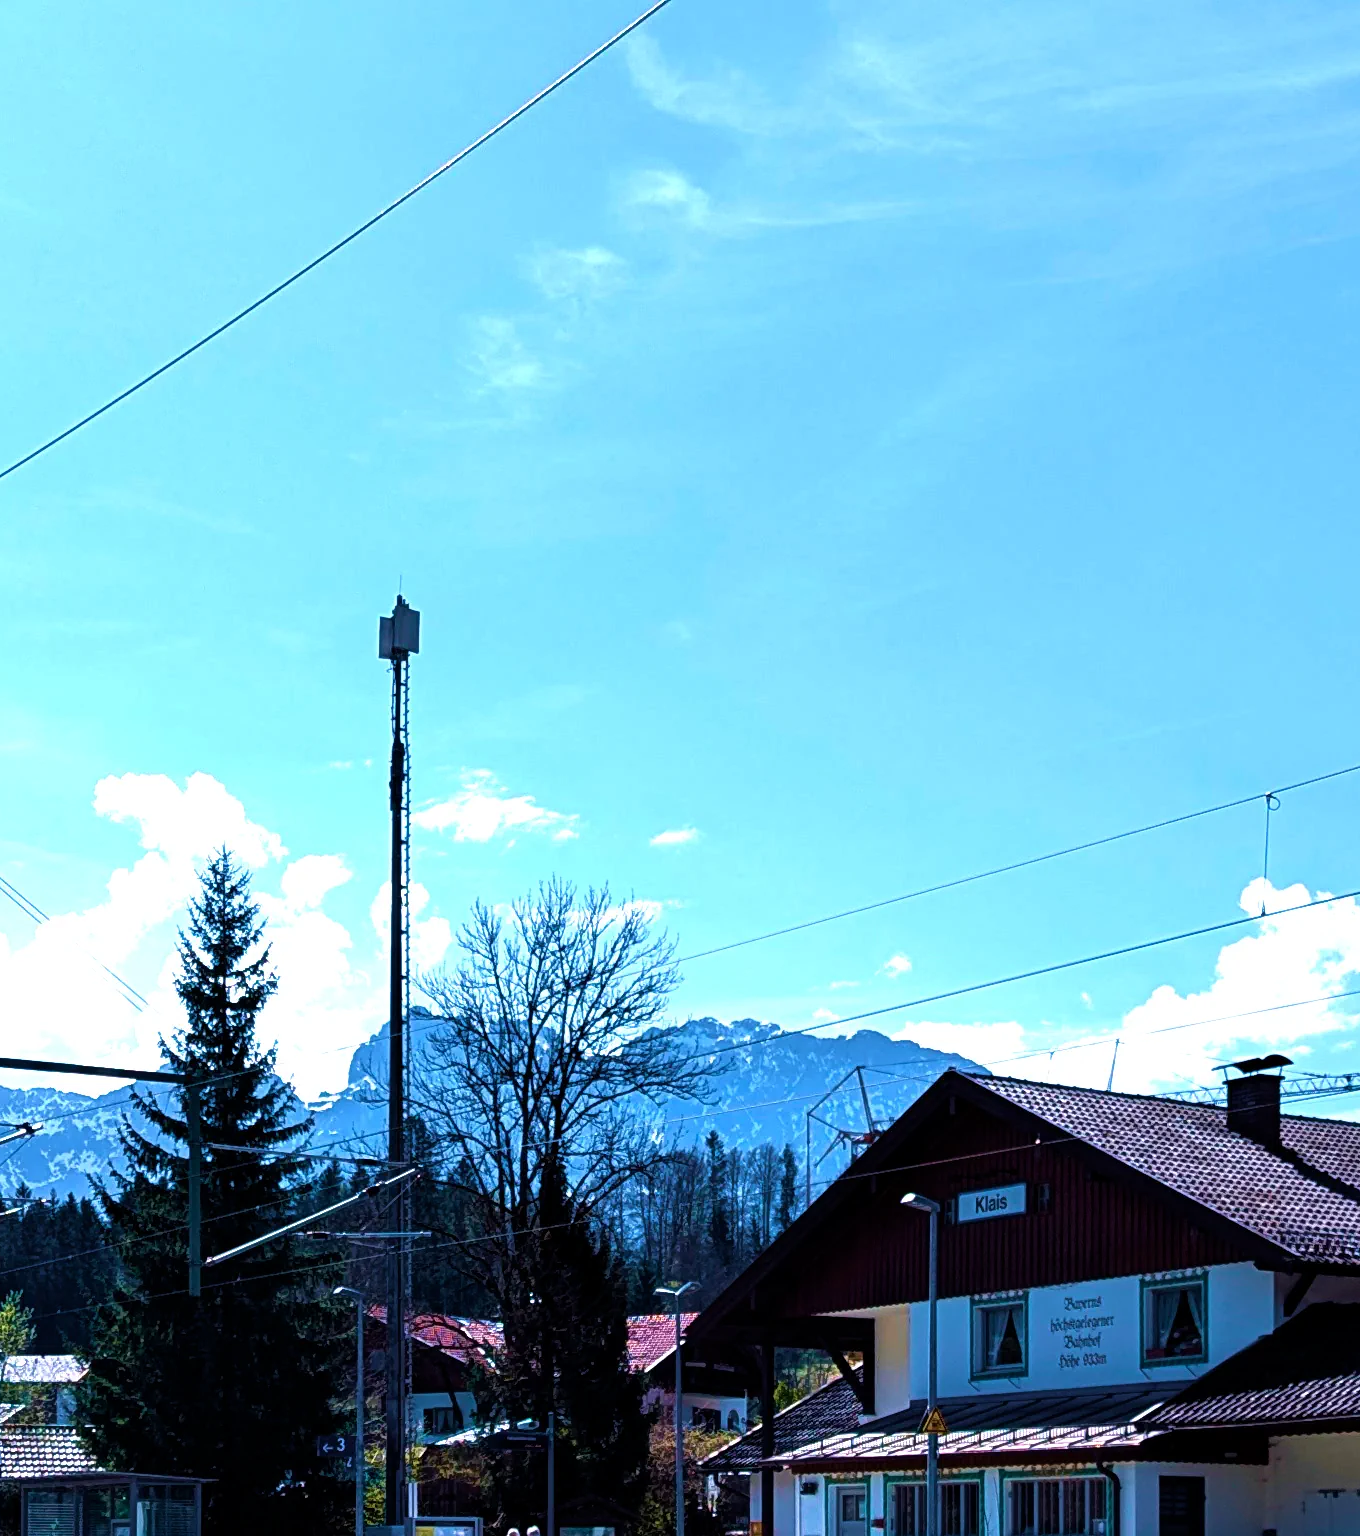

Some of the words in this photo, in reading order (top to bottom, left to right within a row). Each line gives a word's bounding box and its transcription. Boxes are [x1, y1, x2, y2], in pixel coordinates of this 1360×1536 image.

[975, 1196, 1008, 1214] Klais
[1063, 1331, 1102, 1349] Bahnhof
[336, 1437, 346, 1452] 3
